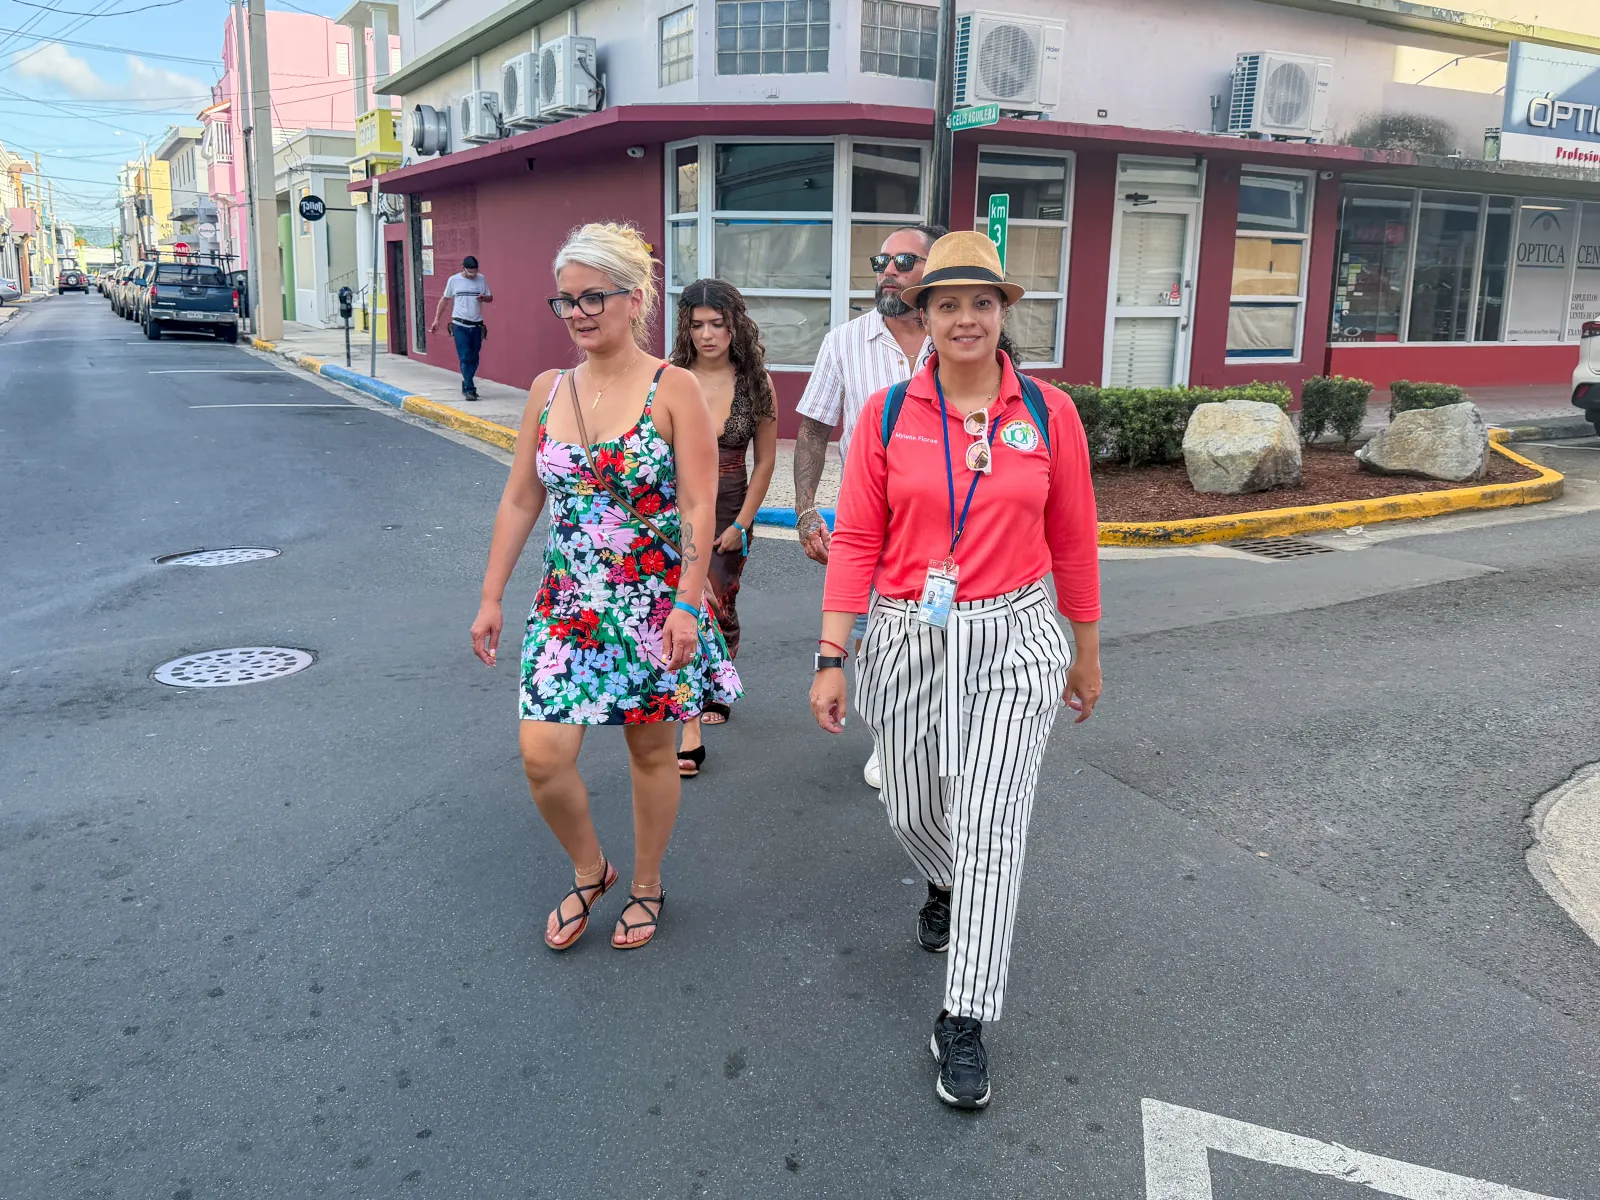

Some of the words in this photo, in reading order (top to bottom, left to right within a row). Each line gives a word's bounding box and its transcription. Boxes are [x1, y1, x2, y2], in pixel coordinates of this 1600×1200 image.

[1045, 45, 1060, 53] Haier
[952, 112, 968, 127] CELIS
[968, 107, 996, 124] AGUILERA
[1528, 92, 1600, 134] ÓPTI
[1556, 146, 1600, 163] Profesio
[991, 203, 1006, 219] km
[993, 223, 1002, 247] 3
[1516, 242, 1565, 264] OPTICA
[1577, 244, 1600, 264] CEN
[1571, 293, 1598, 302] ESPEJUELOS
[1570, 302, 1585, 310] GAFAS
[1569, 311, 1586, 319] LENTES
[1586, 311, 1592, 319] DE
